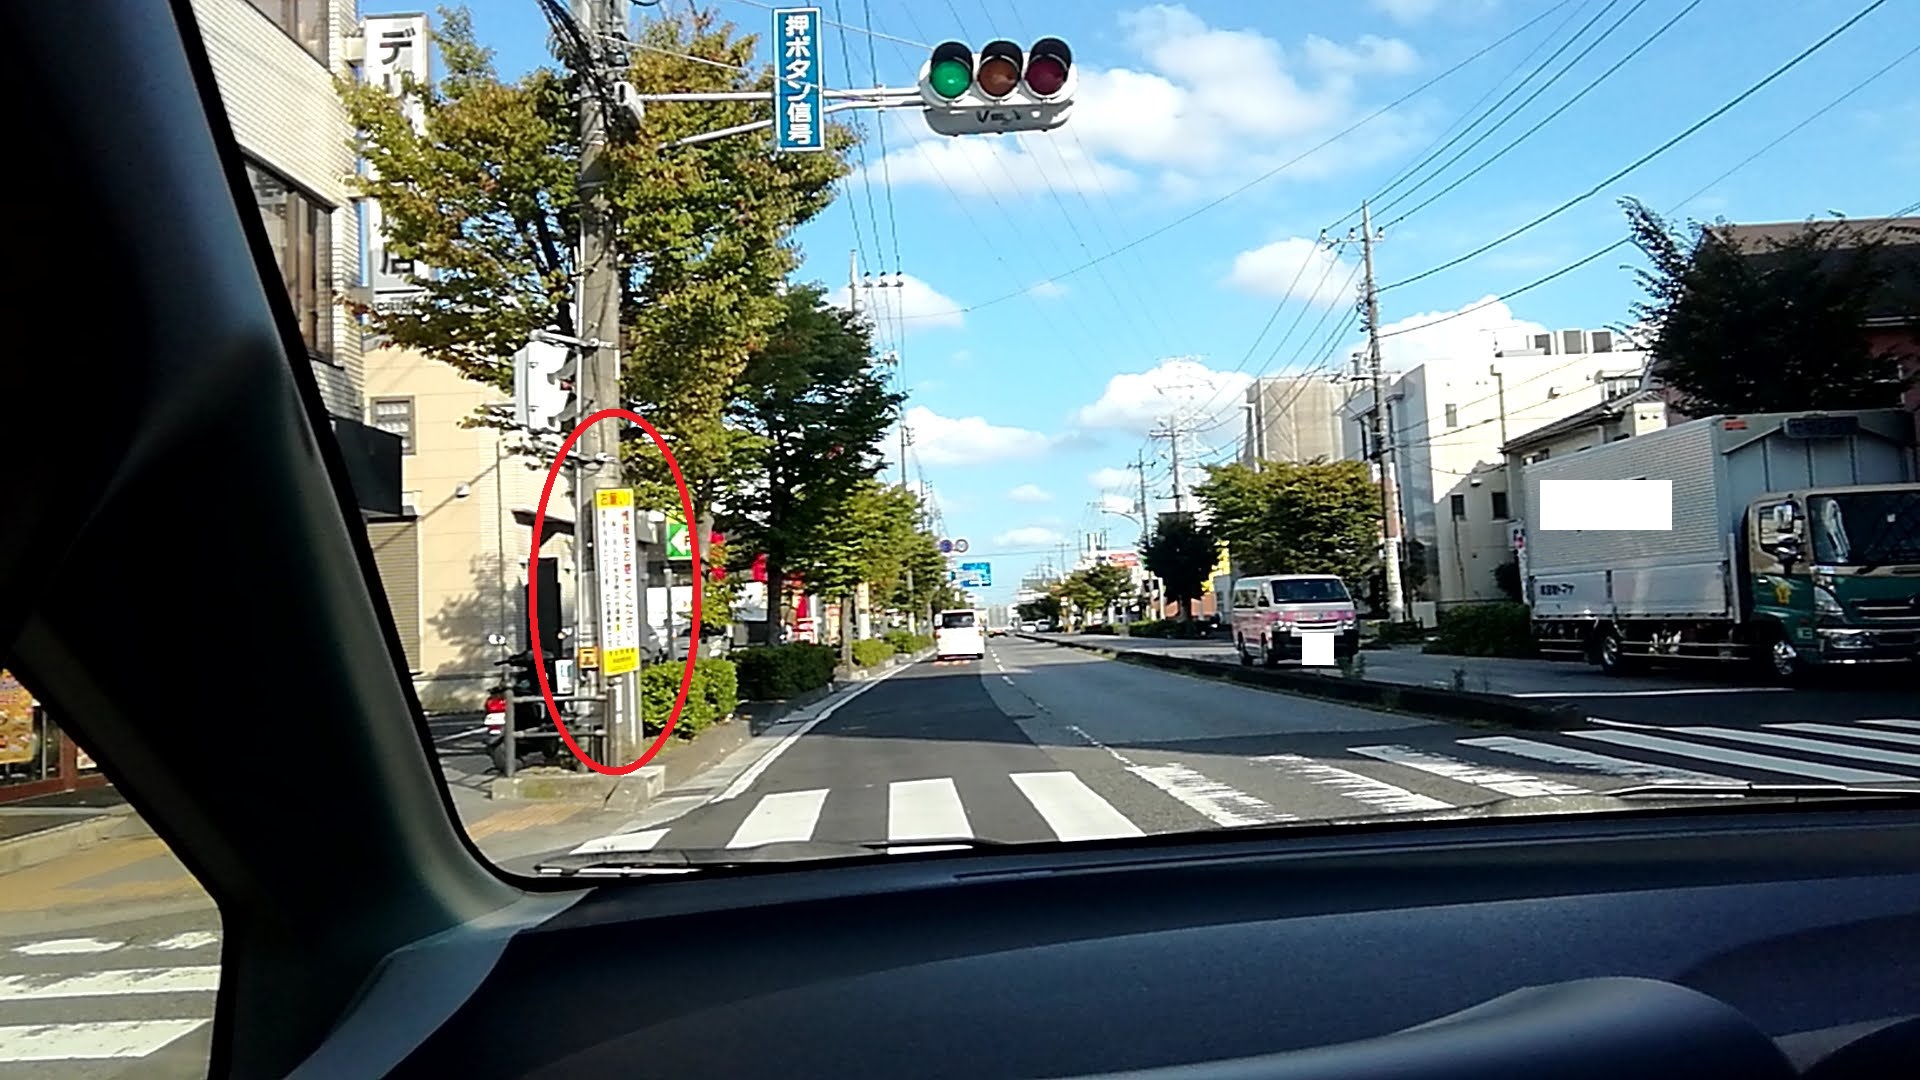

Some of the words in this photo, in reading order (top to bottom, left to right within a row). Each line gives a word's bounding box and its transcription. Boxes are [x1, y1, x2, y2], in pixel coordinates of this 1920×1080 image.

[785, 14, 813, 145] 押ボタン信号
